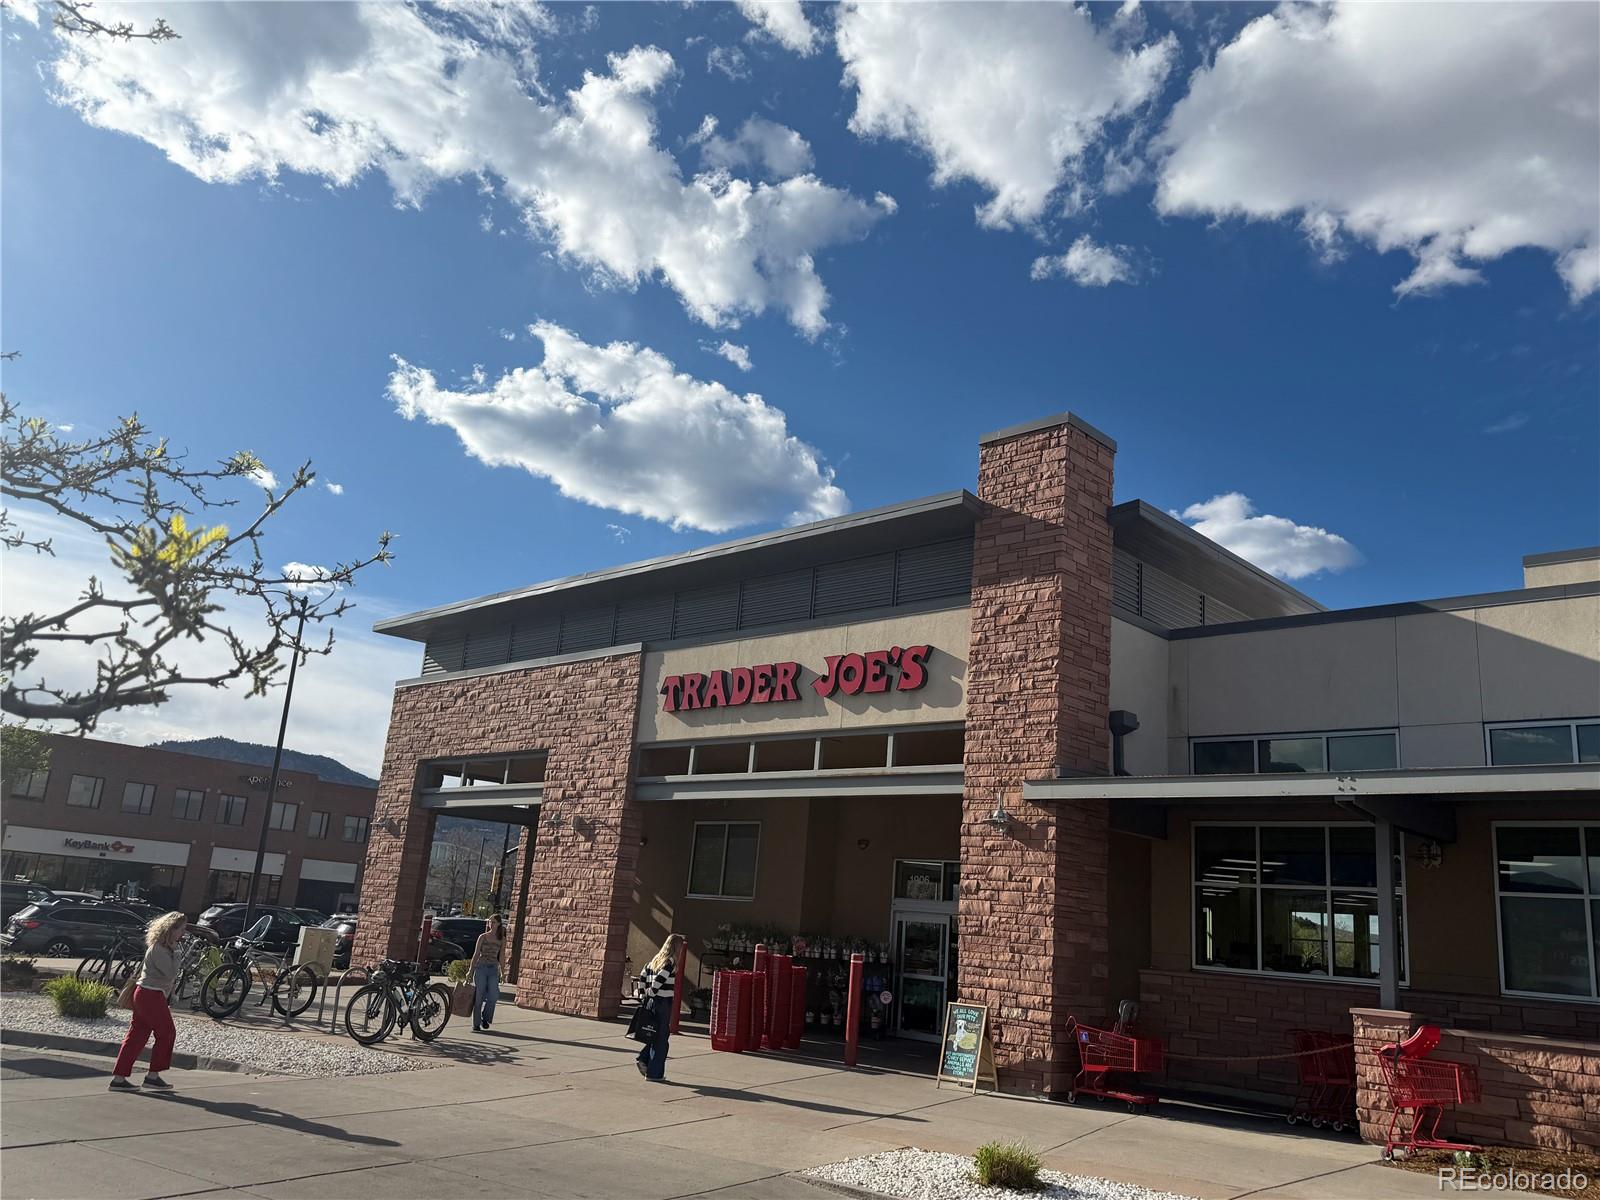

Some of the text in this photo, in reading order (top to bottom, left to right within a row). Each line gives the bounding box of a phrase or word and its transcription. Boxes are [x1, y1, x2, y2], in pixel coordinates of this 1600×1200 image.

[660, 645, 933, 712] TRADER JOE'S
[64, 838, 112, 851] KeyBank
